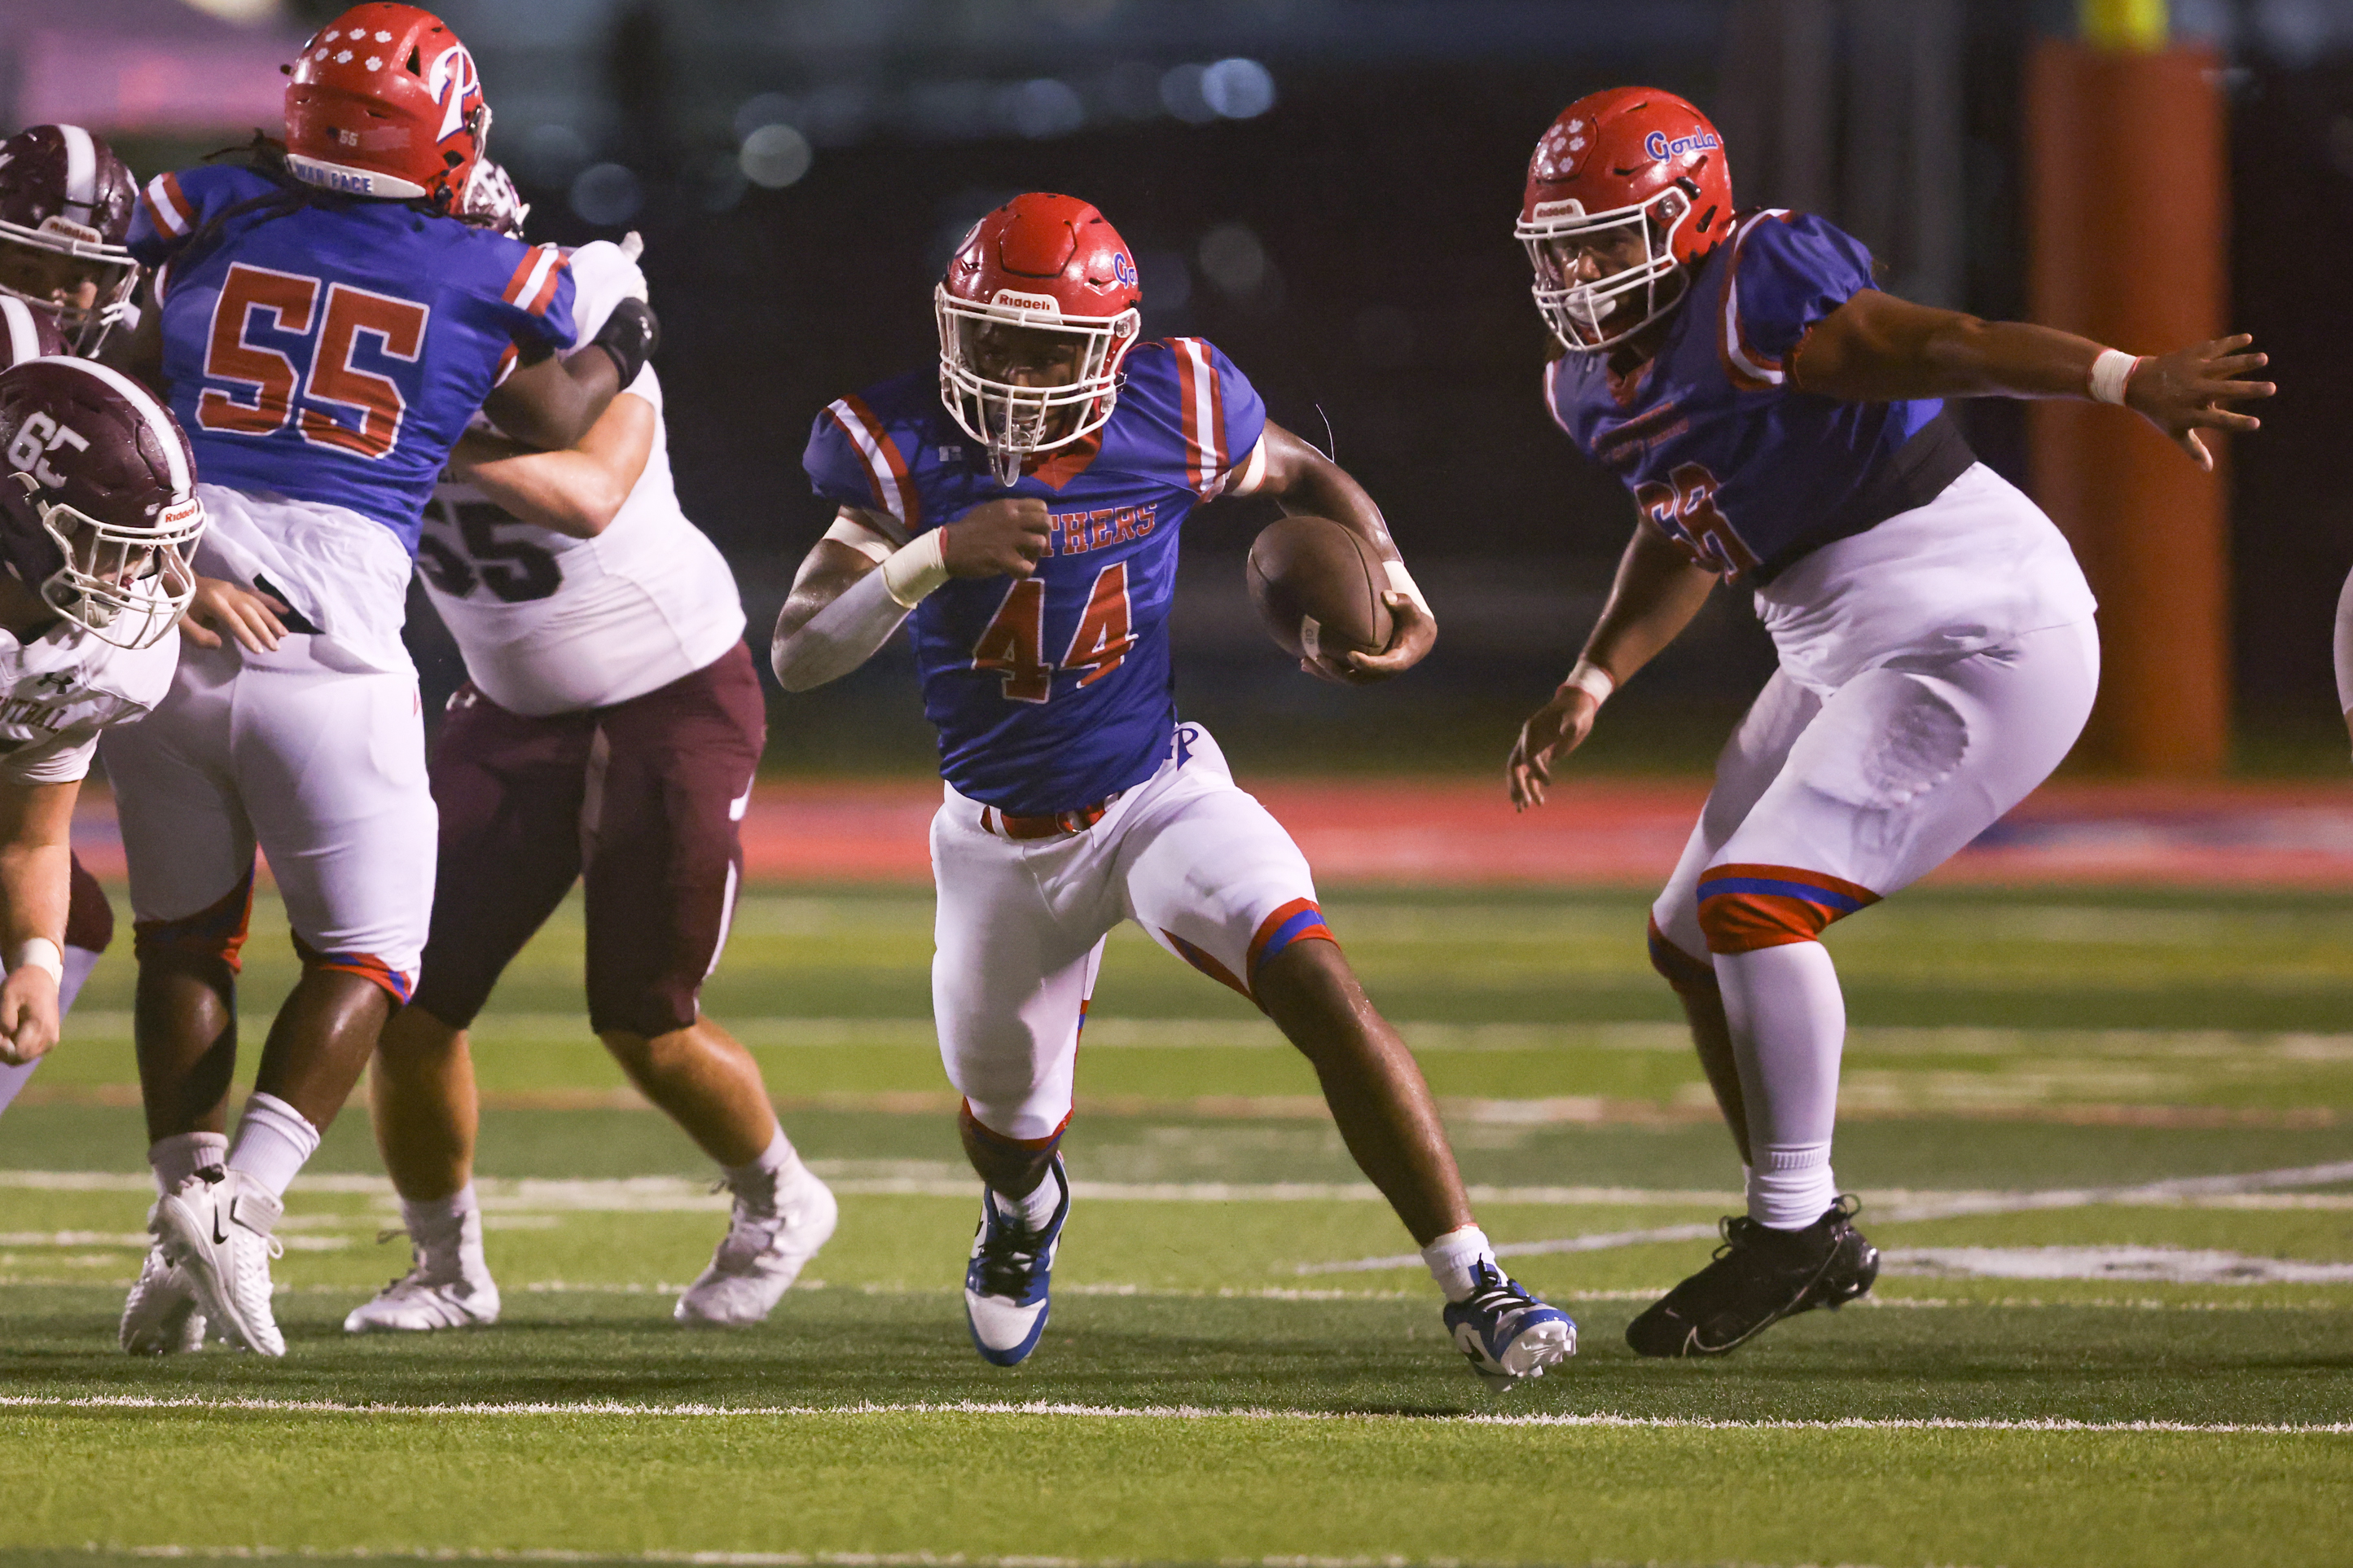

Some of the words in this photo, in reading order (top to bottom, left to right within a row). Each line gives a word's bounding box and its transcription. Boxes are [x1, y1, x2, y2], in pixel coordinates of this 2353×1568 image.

[339, 129, 358, 147] 55
[1644, 125, 1719, 165] Goula
[999, 293, 1051, 311] Riddell
[195, 261, 430, 461] 55
[165, 505, 195, 524] Riddell
[1041, 503, 1158, 557] THERS
[971, 560, 1139, 705] 44
